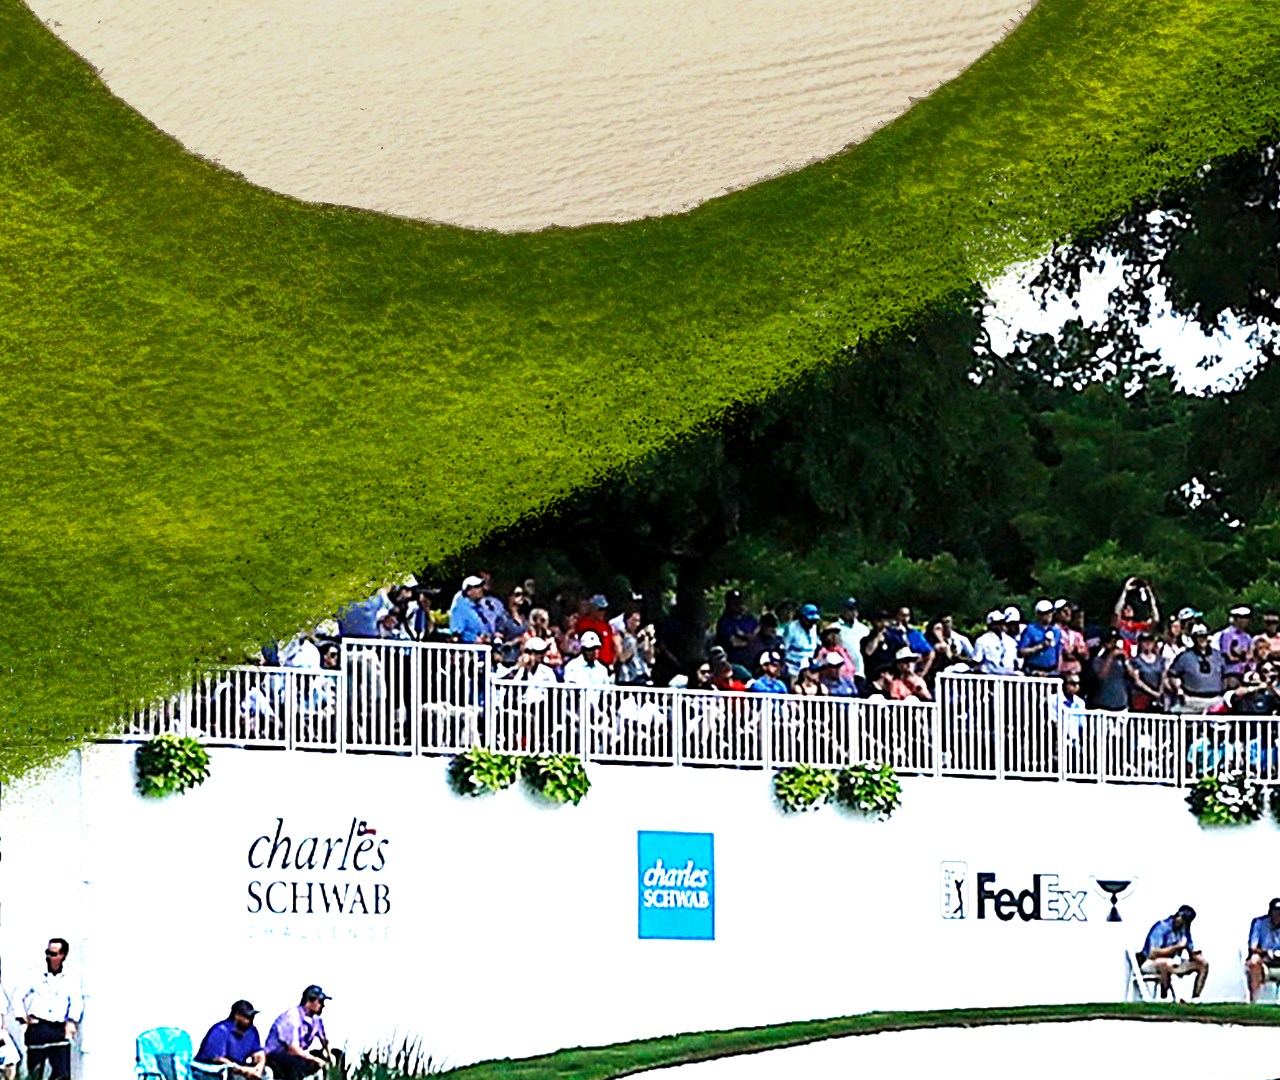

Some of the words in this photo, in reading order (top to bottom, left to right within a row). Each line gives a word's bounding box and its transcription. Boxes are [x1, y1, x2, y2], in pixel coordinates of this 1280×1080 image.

[247, 817, 389, 871] charles
[643, 859, 709, 887] charles
[247, 881, 390, 914] SCHWAB
[643, 888, 709, 908] SCHWAB
[976, 872, 1088, 922] FedEx
